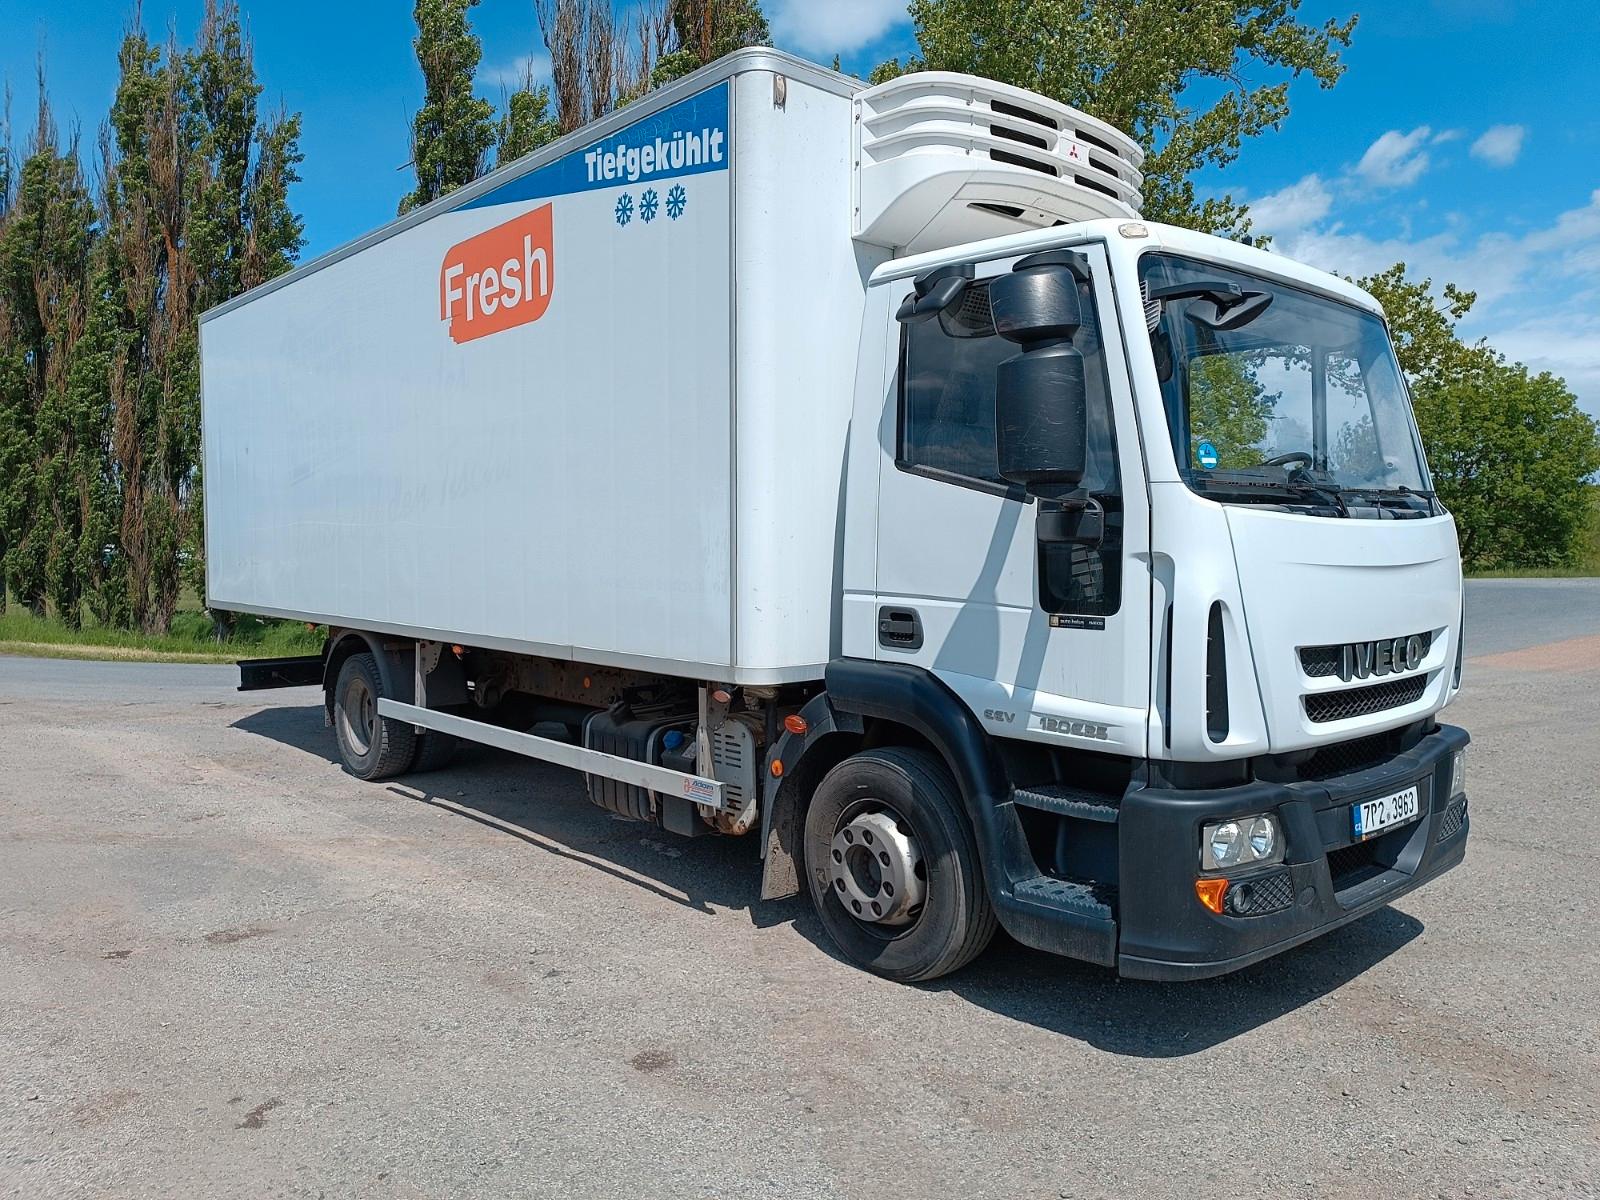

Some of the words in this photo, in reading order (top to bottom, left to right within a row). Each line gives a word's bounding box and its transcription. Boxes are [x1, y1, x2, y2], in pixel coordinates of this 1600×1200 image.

[585, 127, 723, 182] Tiefgekühlt
[444, 234, 547, 321] Fresh
[1344, 637, 1423, 682] IVECO
[984, 709, 1015, 723] EEV
[1364, 801, 1385, 829] 7P2
[1392, 792, 1413, 819] 3963
